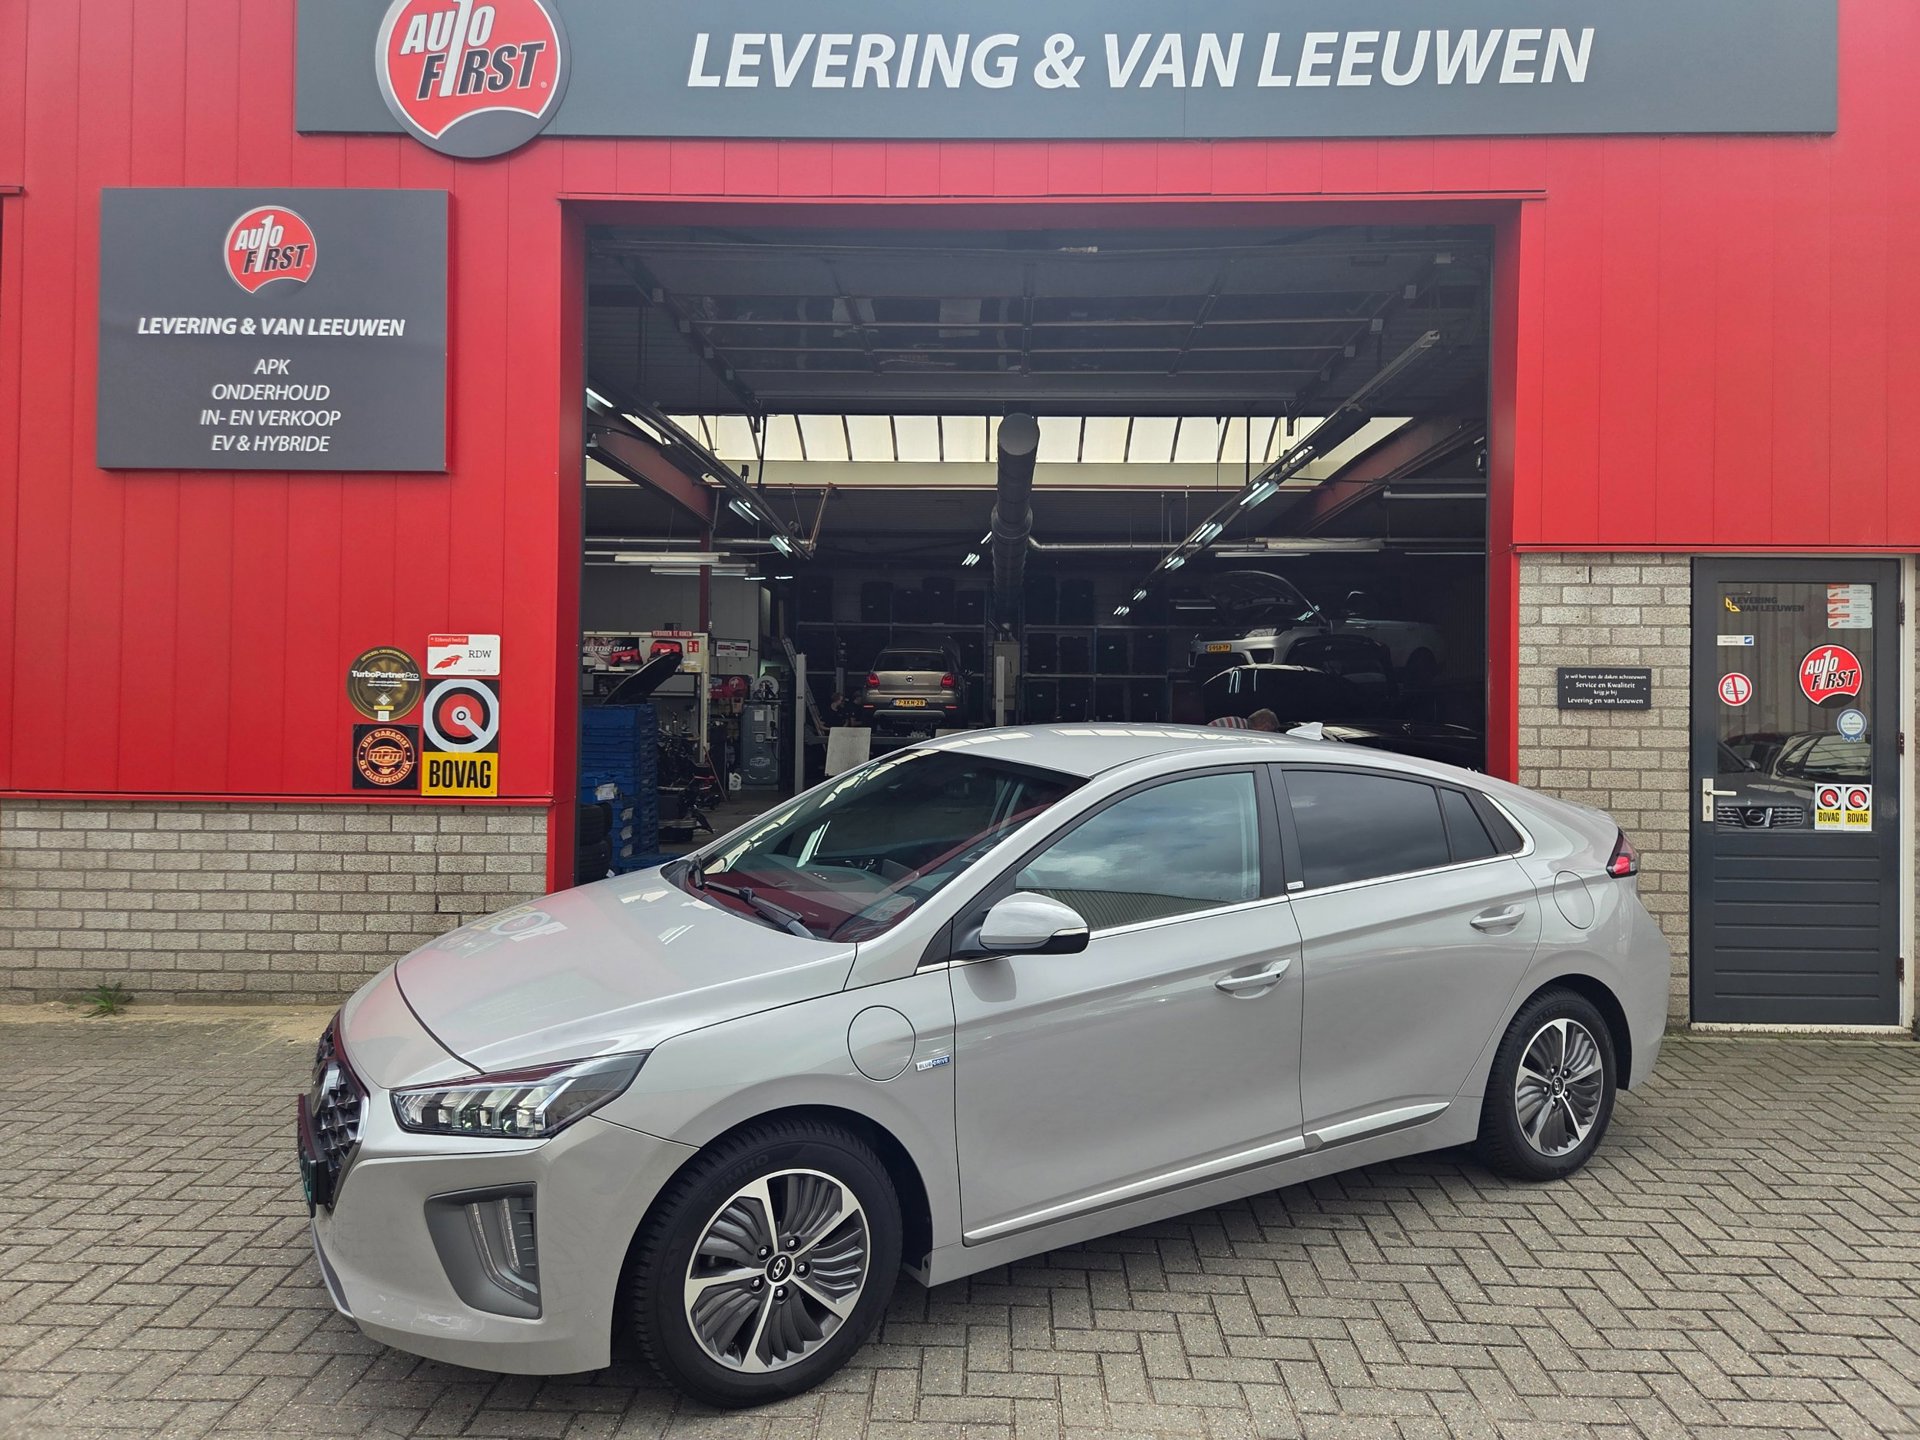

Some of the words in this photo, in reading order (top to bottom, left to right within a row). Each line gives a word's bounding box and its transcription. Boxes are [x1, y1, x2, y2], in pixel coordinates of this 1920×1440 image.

[686, 32, 1020, 89] LEVERING
[1033, 33, 1086, 89] &
[1103, 32, 1244, 88] VAN
[1256, 28, 1595, 88] LEEUWEN
[137, 317, 237, 336] LEVERING
[240, 318, 256, 336] &
[261, 318, 305, 336] VAN
[307, 318, 406, 337] LEEUWEN
[254, 359, 291, 375] APK
[211, 384, 331, 401] ONDERHOUD
[200, 410, 227, 426] IN-
[230, 410, 254, 426] EN
[258, 410, 341, 427] VERKOOP
[211, 435, 236, 451] EV
[237, 435, 251, 451] &
[254, 435, 331, 452] HYBRIDE
[1732, 596, 1778, 604] LEVERING
[1761, 604, 1805, 612] LEEUWEN
[468, 650, 492, 659] RDW
[351, 670, 420, 679] TurboPartnerPro
[1575, 681, 1597, 689] Service
[1607, 681, 1636, 689] Kwaliteit
[1567, 697, 1593, 705] Levering
[362, 735, 374, 748] UW
[374, 730, 410, 748] GARAGIST
[429, 759, 492, 789] BOVAG
[1818, 812, 1840, 822] BOVAG
[1847, 813, 1868, 823] BOVAG
